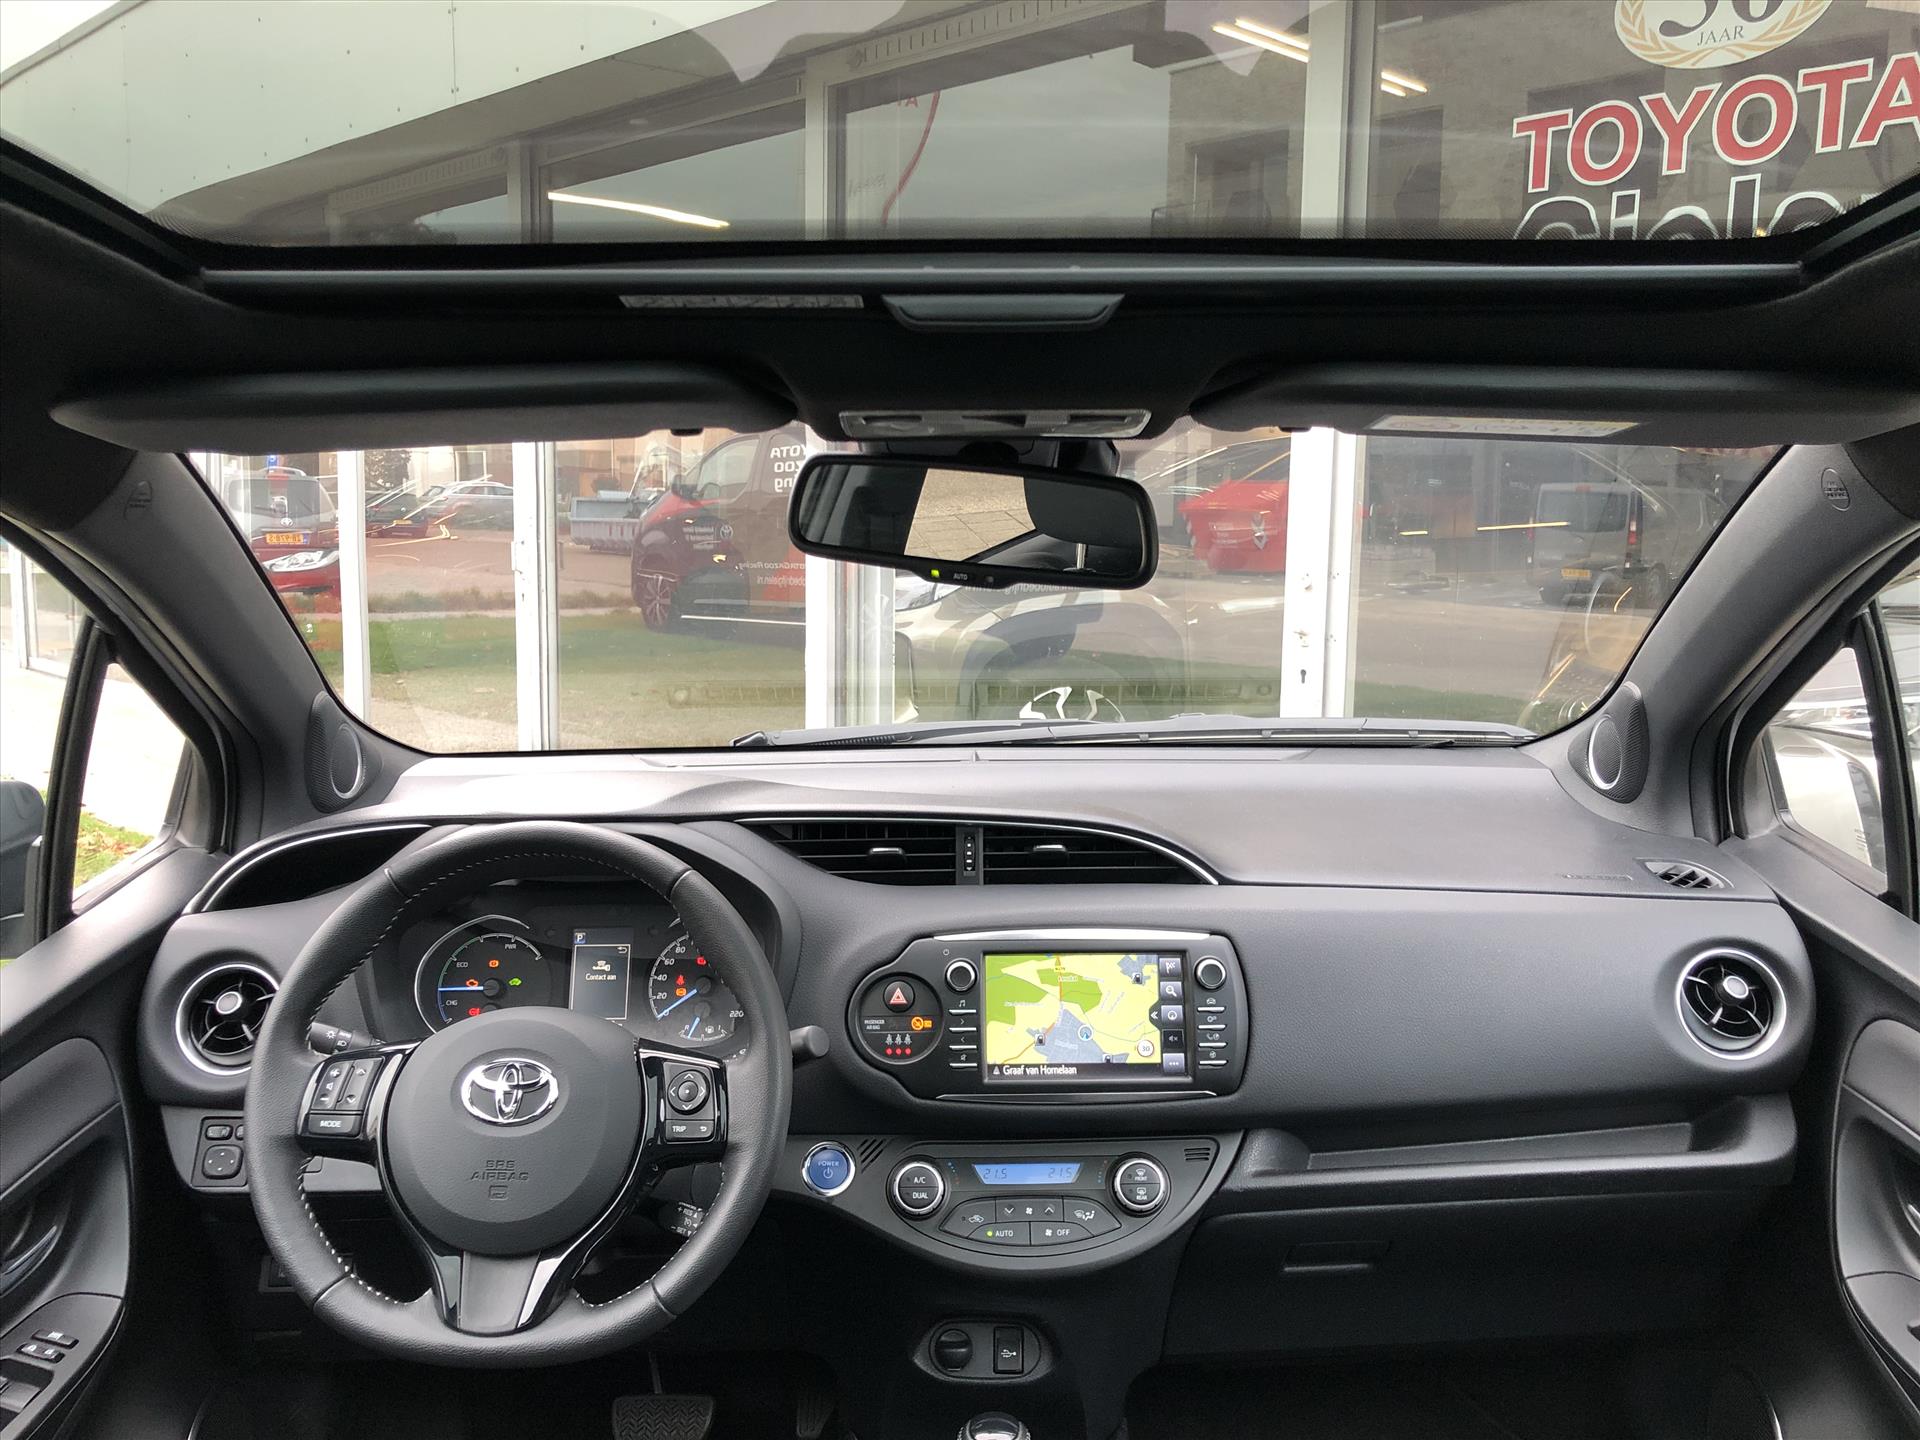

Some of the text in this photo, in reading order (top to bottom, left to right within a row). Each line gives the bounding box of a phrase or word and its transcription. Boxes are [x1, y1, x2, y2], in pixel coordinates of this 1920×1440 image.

[1697, 25, 1745, 46] JAAR
[1513, 51, 1920, 193] TOYOTA
[1003, 1065, 1024, 1075] Graaf
[1026, 1067, 1039, 1075] van
[320, 1120, 341, 1128] MODE
[485, 1160, 515, 1168] SRS
[470, 1171, 529, 1181] AIRBAG
